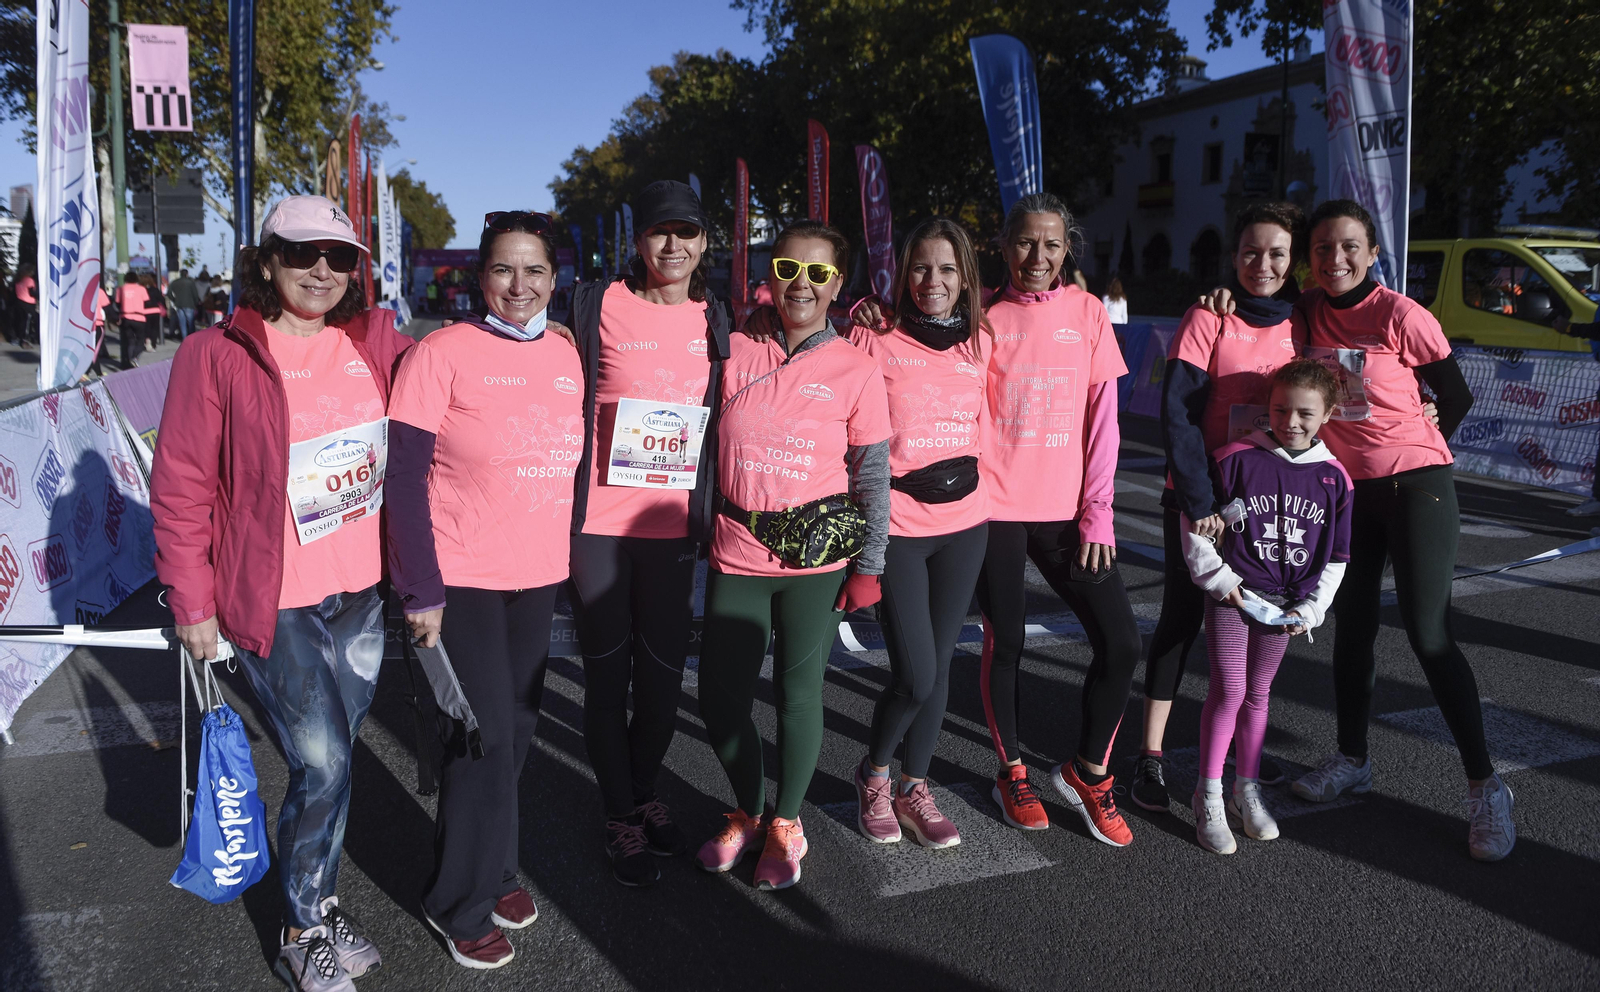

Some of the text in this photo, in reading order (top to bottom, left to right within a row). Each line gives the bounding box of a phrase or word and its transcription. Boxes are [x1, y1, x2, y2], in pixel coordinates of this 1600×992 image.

[1225, 330, 1257, 344] OYSHO
[617, 340, 659, 351] OYSHO
[888, 356, 927, 367] OYSHO
[280, 368, 312, 380] SHO
[484, 376, 527, 386] OYSHO
[1502, 383, 1547, 410] COSMO
[952, 410, 974, 421] POR
[1558, 397, 1600, 425] COSM
[646, 416, 681, 428] ASTURIANA
[934, 422, 971, 434] TODAS
[1460, 418, 1504, 443] COSMO
[564, 434, 583, 446] POR
[642, 435, 679, 453] 016
[785, 435, 816, 451] POR
[907, 436, 970, 448] NOSOTRAS
[1045, 433, 1070, 448] 2019
[319, 446, 366, 465] ASTURIANA
[652, 454, 667, 464] 418
[765, 447, 812, 467] TODAS
[628, 461, 654, 470] CARRERA
[736, 457, 809, 481] NOSOTRAS
[325, 464, 370, 493] 016
[612, 471, 643, 481] OYSHO
[340, 488, 362, 503] 2903
[318, 505, 348, 518] CARRERA
[348, 500, 357, 508] DE
[357, 497, 366, 505] LA
[1250, 493, 1325, 525] HOY PUEDO
[304, 519, 338, 537] OYSHO
